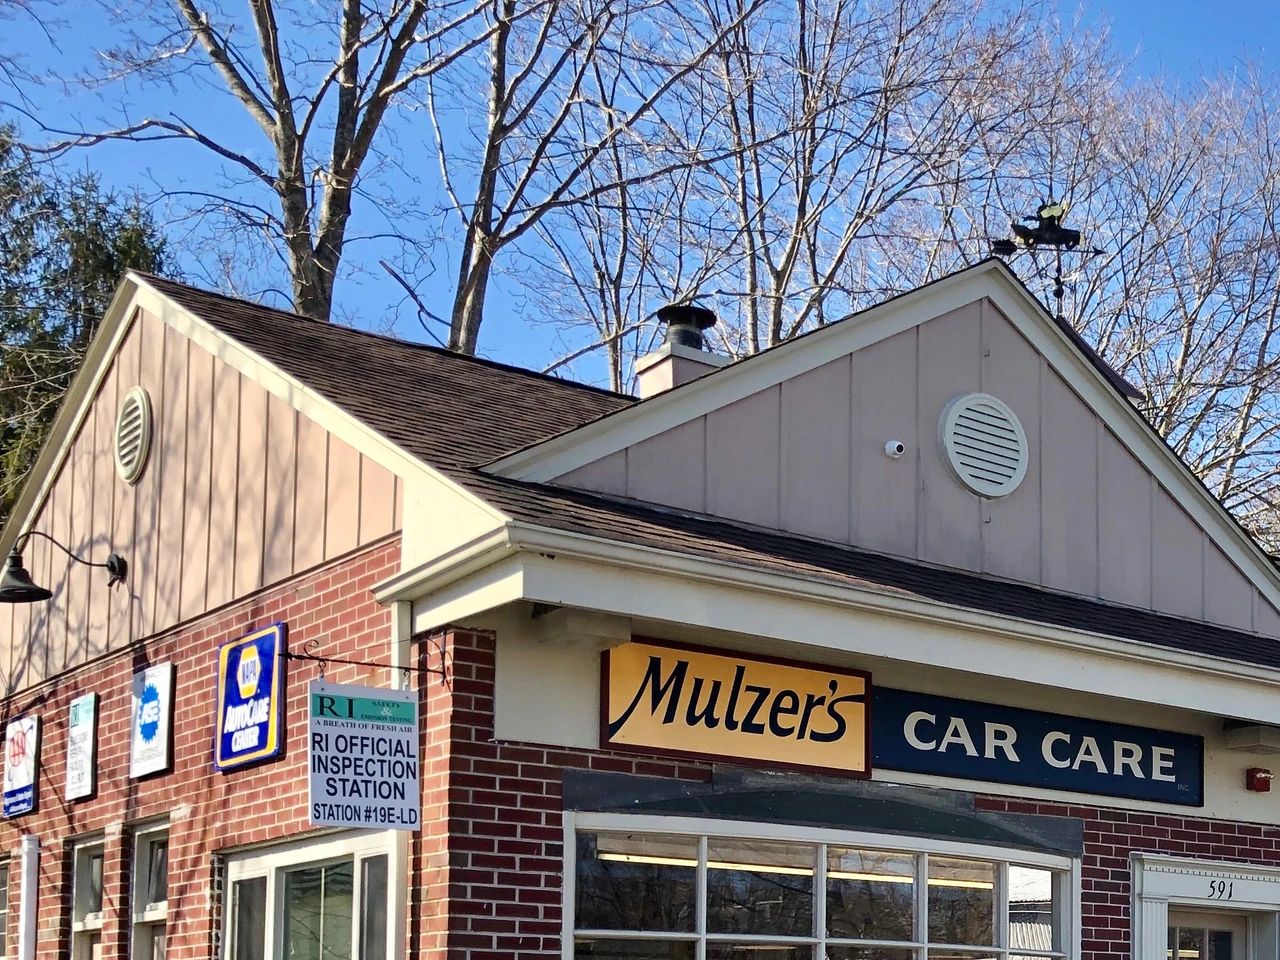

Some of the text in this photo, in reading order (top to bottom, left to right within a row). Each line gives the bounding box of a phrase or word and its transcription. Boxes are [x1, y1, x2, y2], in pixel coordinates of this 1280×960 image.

[370, 701, 401, 709] SAFETY
[608, 654, 866, 744] Mulzer's
[360, 714, 388, 723] EMISSION
[380, 706, 393, 716] &
[323, 719, 357, 729] BREATH
[358, 722, 370, 730] OF
[371, 724, 398, 732] FRESH
[399, 726, 413, 734] AIR
[231, 726, 260, 753] CENTER
[312, 732, 416, 759] RI OFFICIAL
[902, 710, 1178, 784] CAR CARE
[312, 754, 417, 780] INSPECTION
[325, 777, 406, 801] STATION
[1177, 783, 1190, 792] INC
[313, 803, 418, 825] STATION #19E-LD
[1207, 879, 1235, 900] 591
